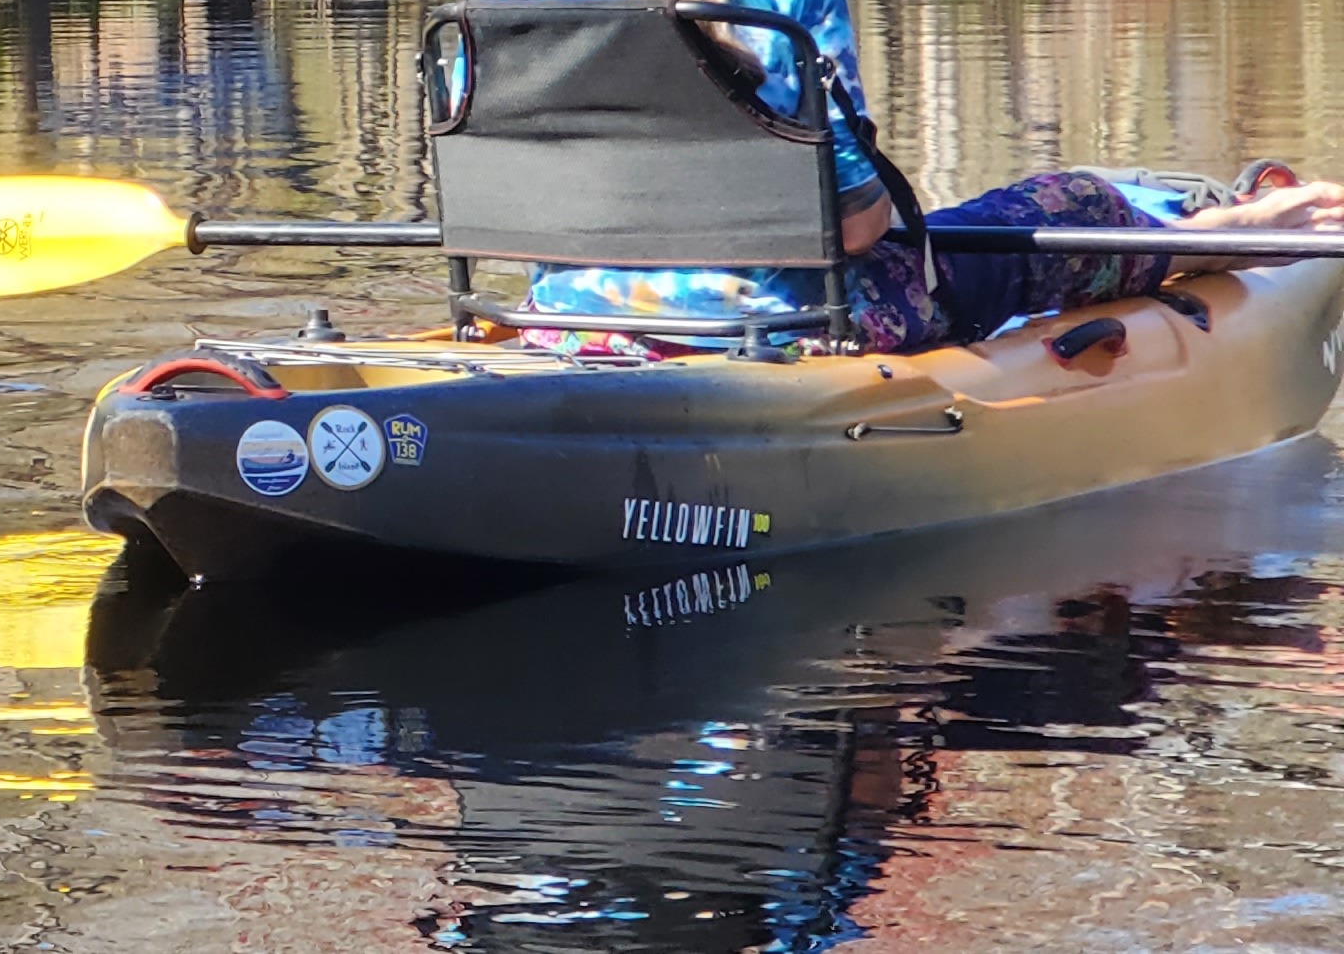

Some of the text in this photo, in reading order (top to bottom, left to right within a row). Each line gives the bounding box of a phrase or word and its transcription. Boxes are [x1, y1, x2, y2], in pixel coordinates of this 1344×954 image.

[391, 420, 421, 438] RUM
[396, 442, 417, 459] 138
[622, 497, 751, 548] YELLOWFIN
